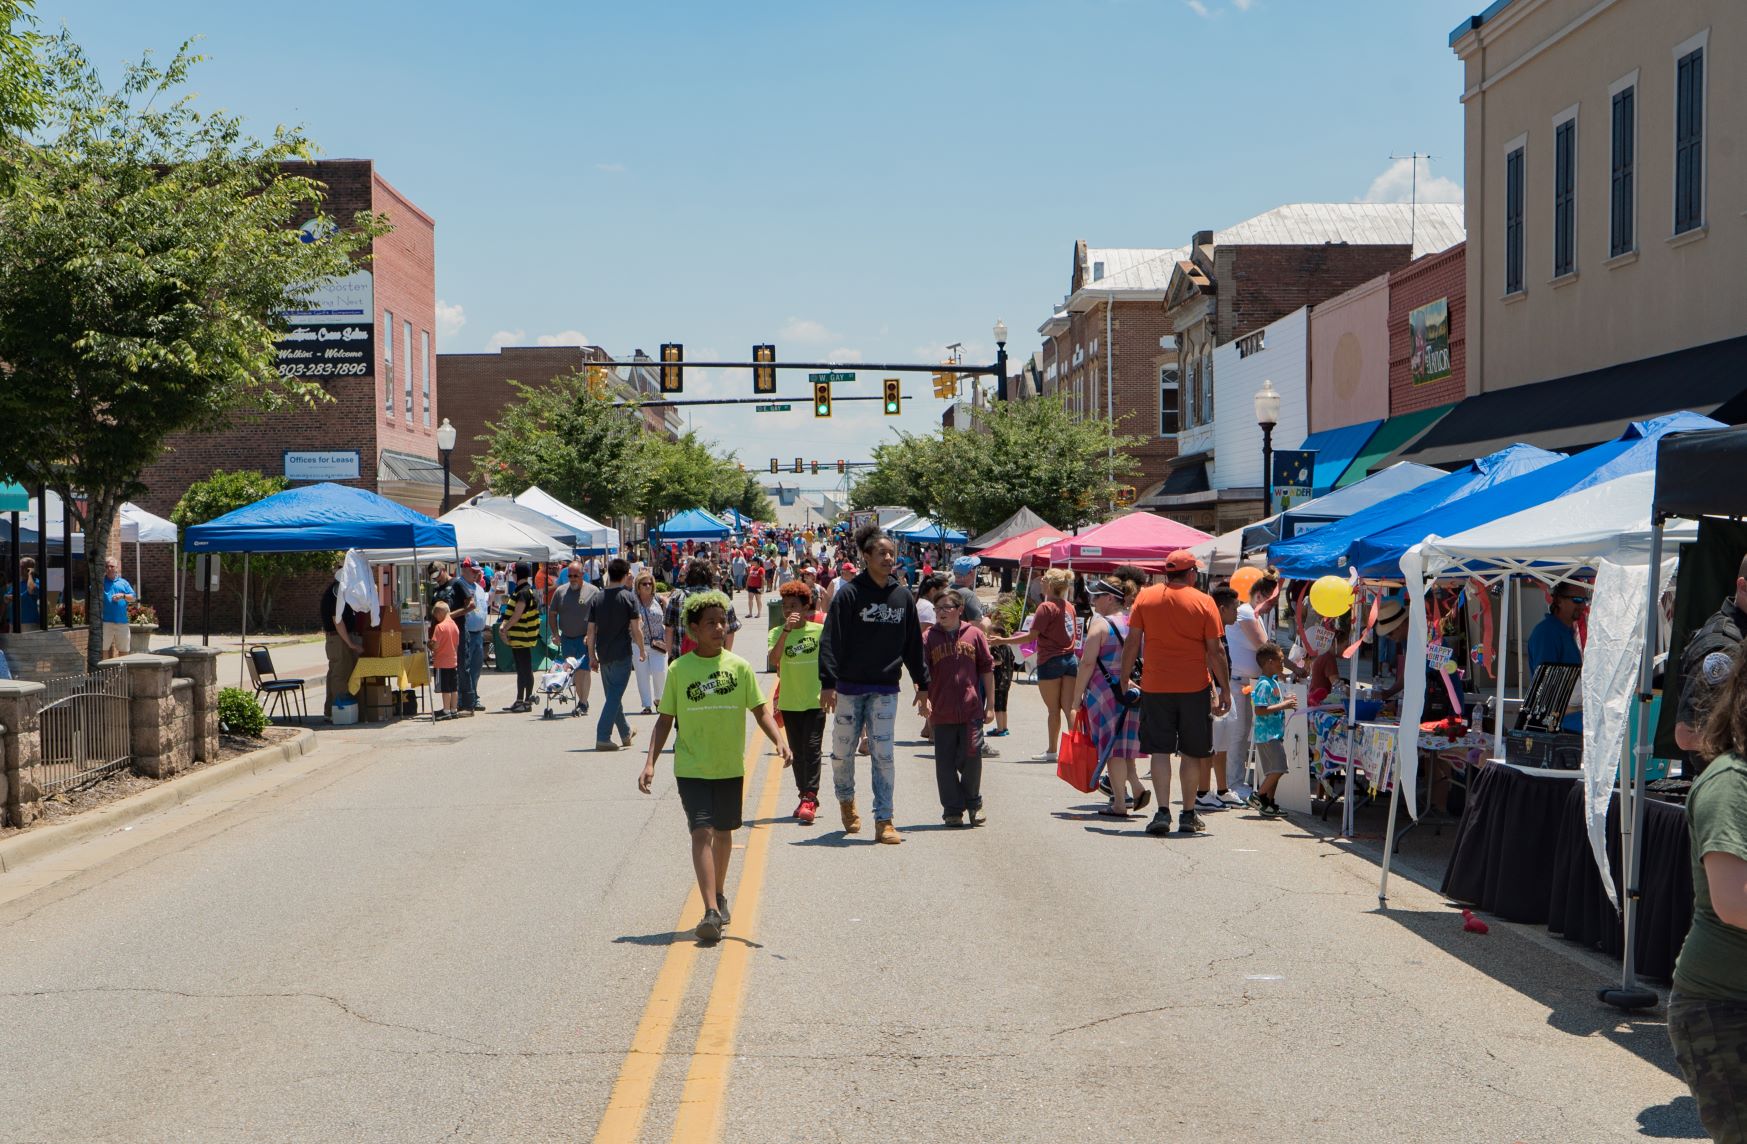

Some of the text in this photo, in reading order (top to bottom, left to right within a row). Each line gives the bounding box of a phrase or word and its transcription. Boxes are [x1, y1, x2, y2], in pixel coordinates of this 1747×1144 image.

[324, 348, 363, 359] Welcome
[278, 362, 368, 376] 803-283-1896
[289, 456, 354, 464] Offices for Lease
[1429, 645, 1452, 656] HAPPY
[1428, 652, 1449, 664] BIRTH
[1430, 660, 1444, 669] DAY
